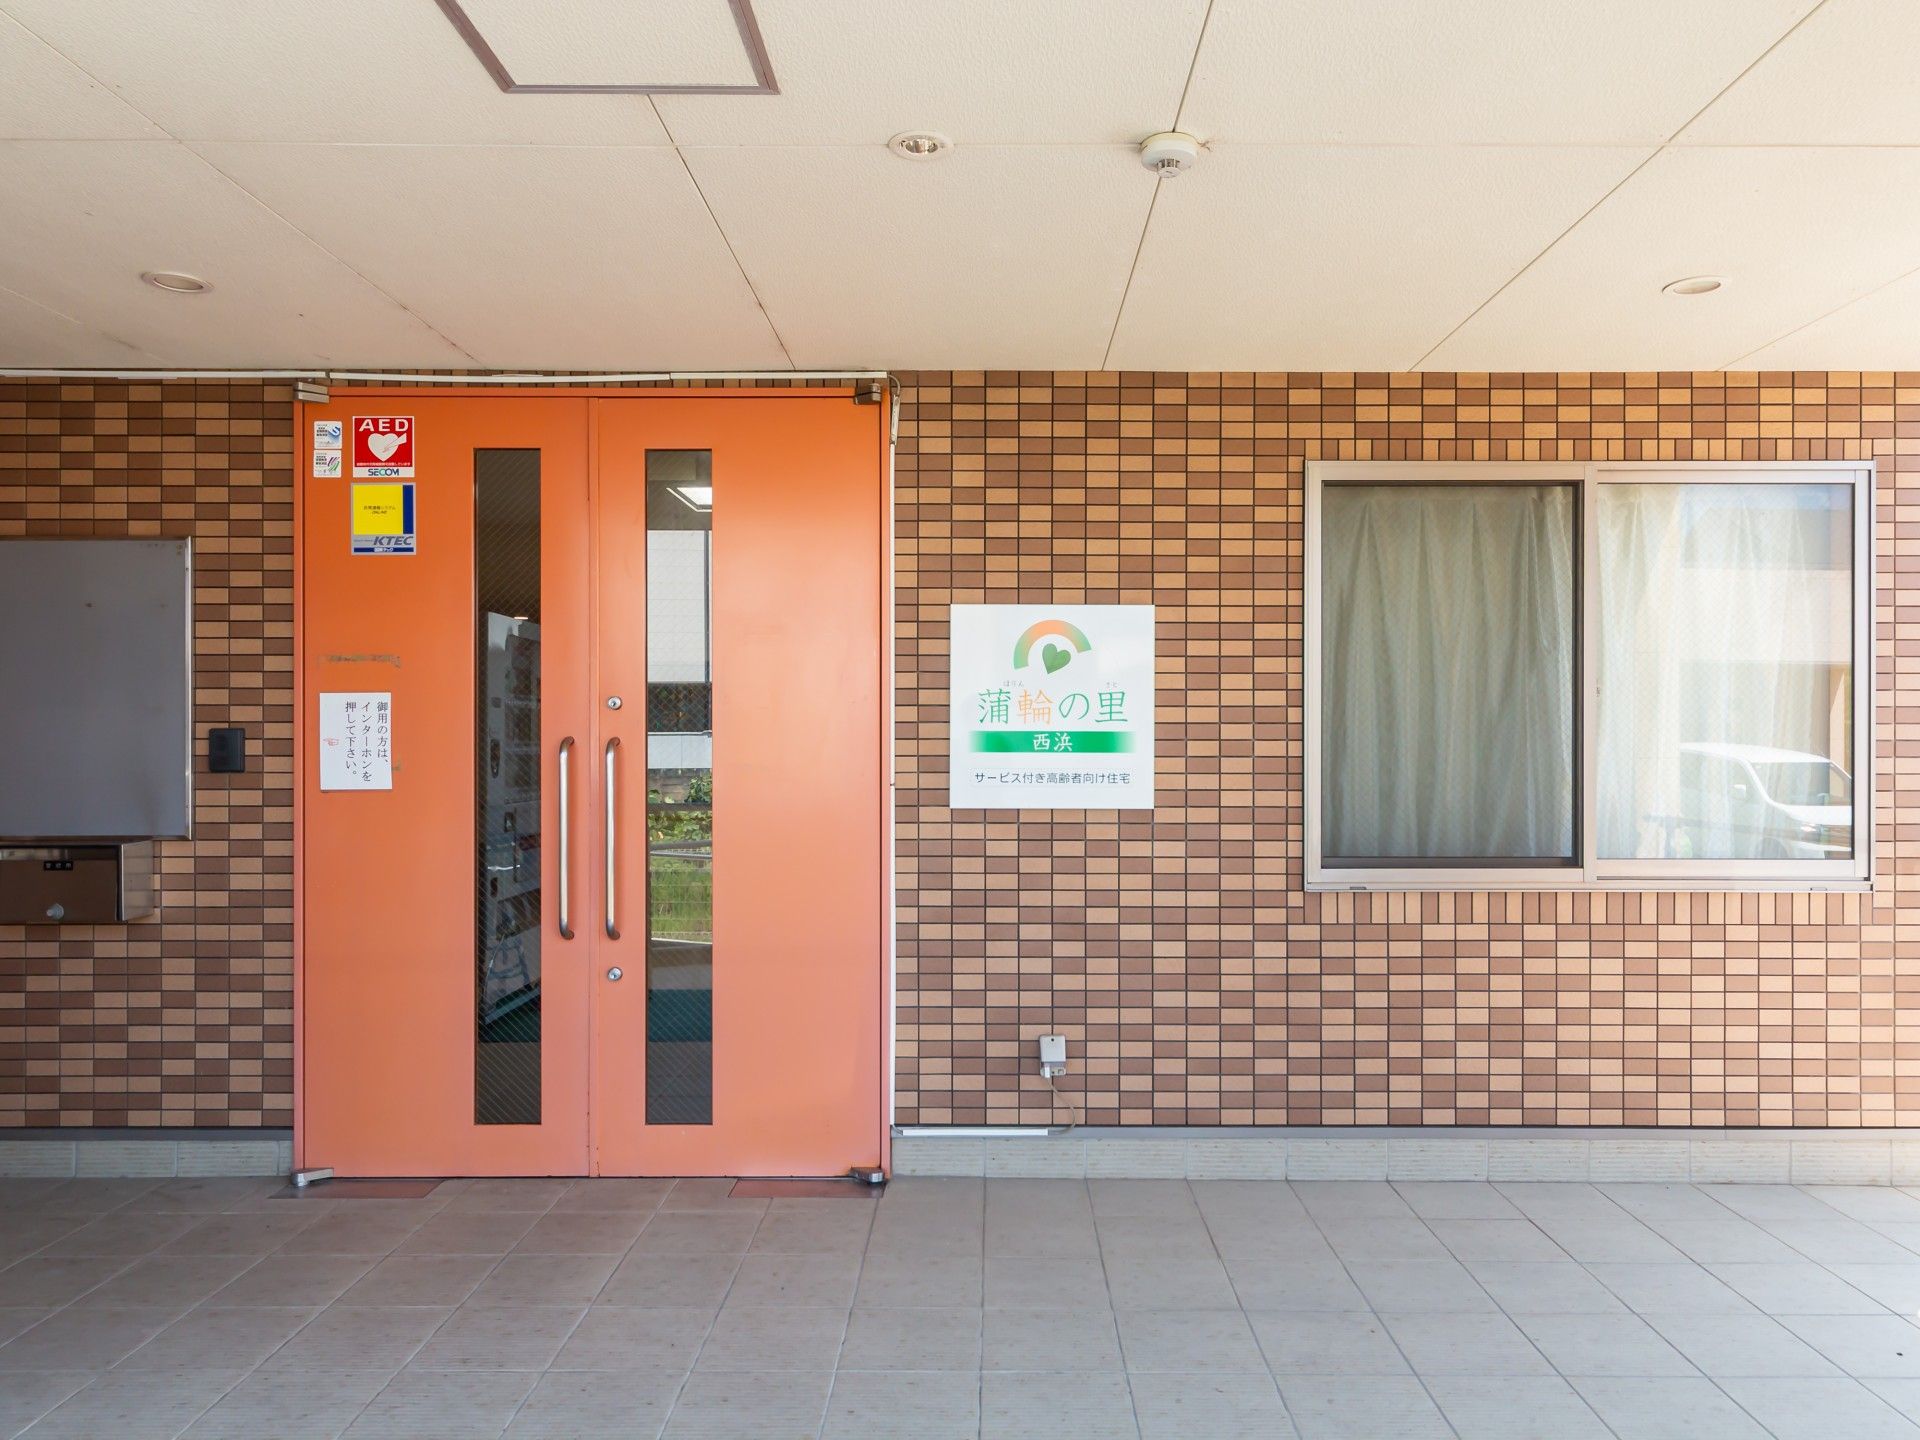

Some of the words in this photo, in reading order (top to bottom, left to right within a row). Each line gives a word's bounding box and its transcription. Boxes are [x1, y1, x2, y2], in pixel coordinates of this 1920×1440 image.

[359, 419, 409, 432] AED
[368, 468, 400, 477] SECOM
[373, 536, 414, 546] KTEC
[978, 689, 1128, 725] 蒲輪の里
[345, 701, 357, 775] 押して下さい。
[361, 702, 372, 782] インターホンを
[377, 701, 389, 763] 御用の方は、
[1033, 732, 1072, 752] 西浜
[975, 772, 1131, 785] サービス付き高齢者向け住宅
